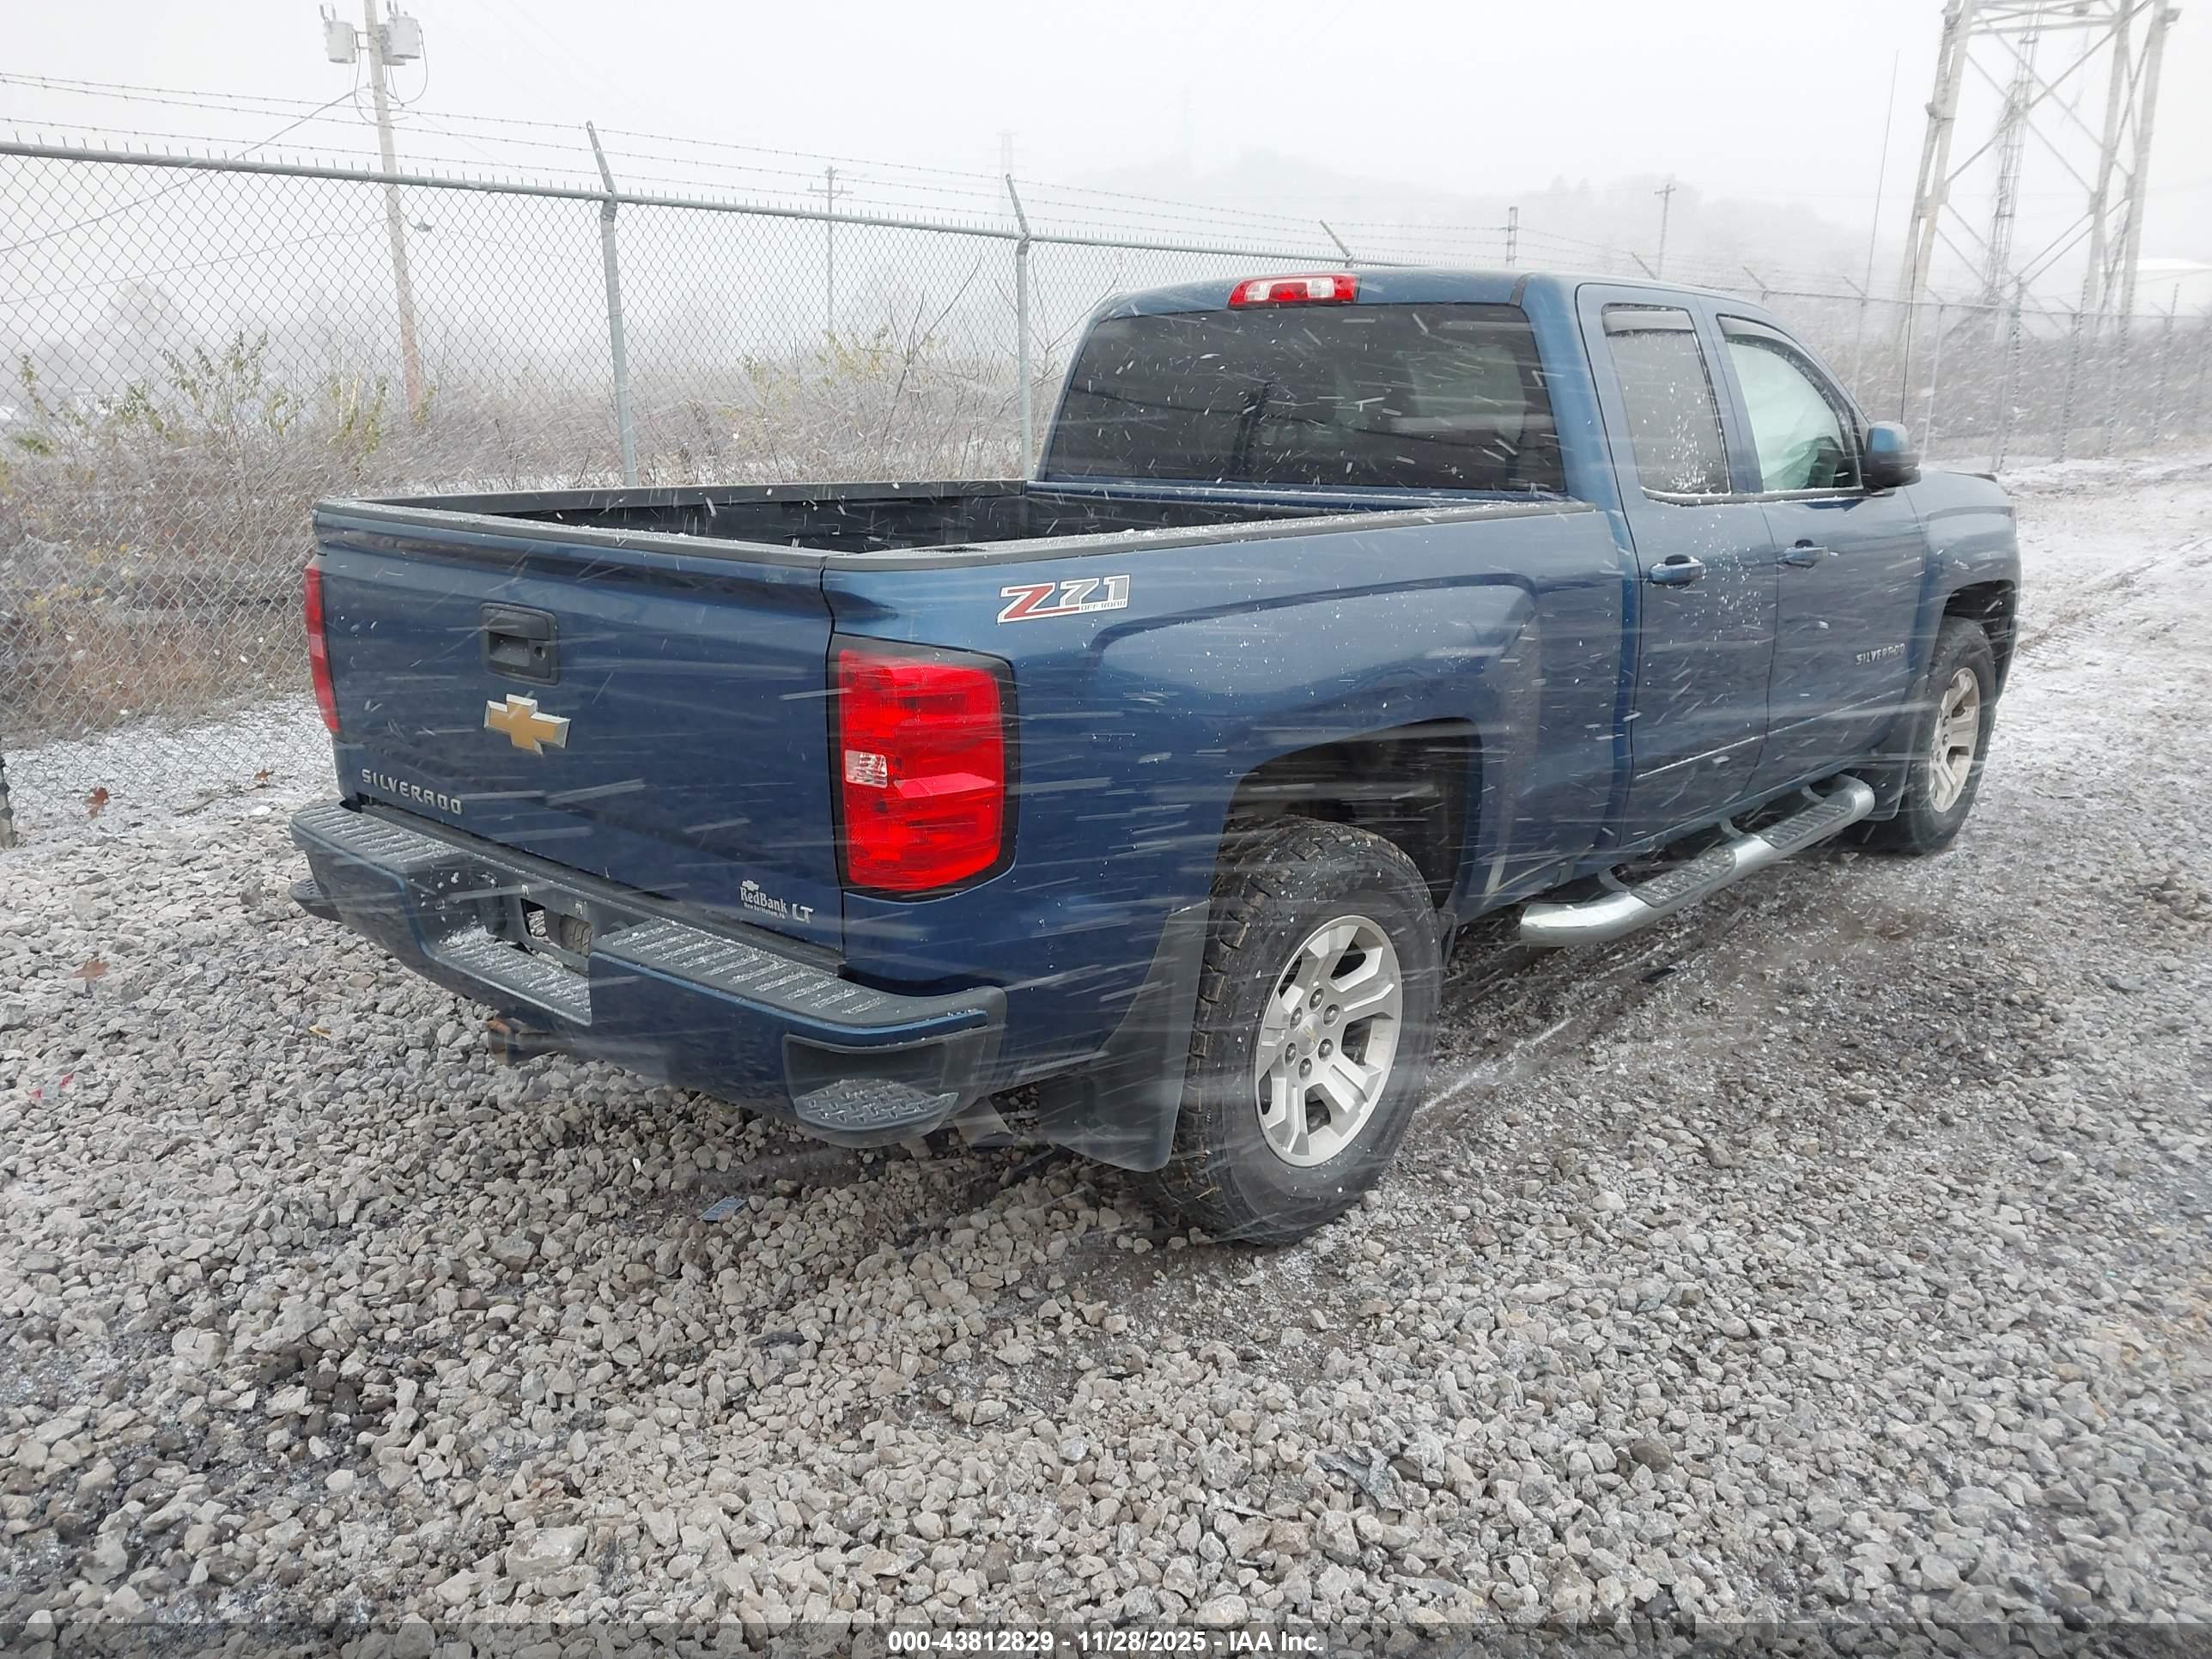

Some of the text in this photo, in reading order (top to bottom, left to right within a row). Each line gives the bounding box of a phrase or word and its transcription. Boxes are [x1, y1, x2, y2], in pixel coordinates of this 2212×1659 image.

[997, 574, 1130, 623] Z71
[362, 769, 463, 816] SILVERADO
[739, 886, 787, 914] RedBank
[792, 902, 814, 924] LT
